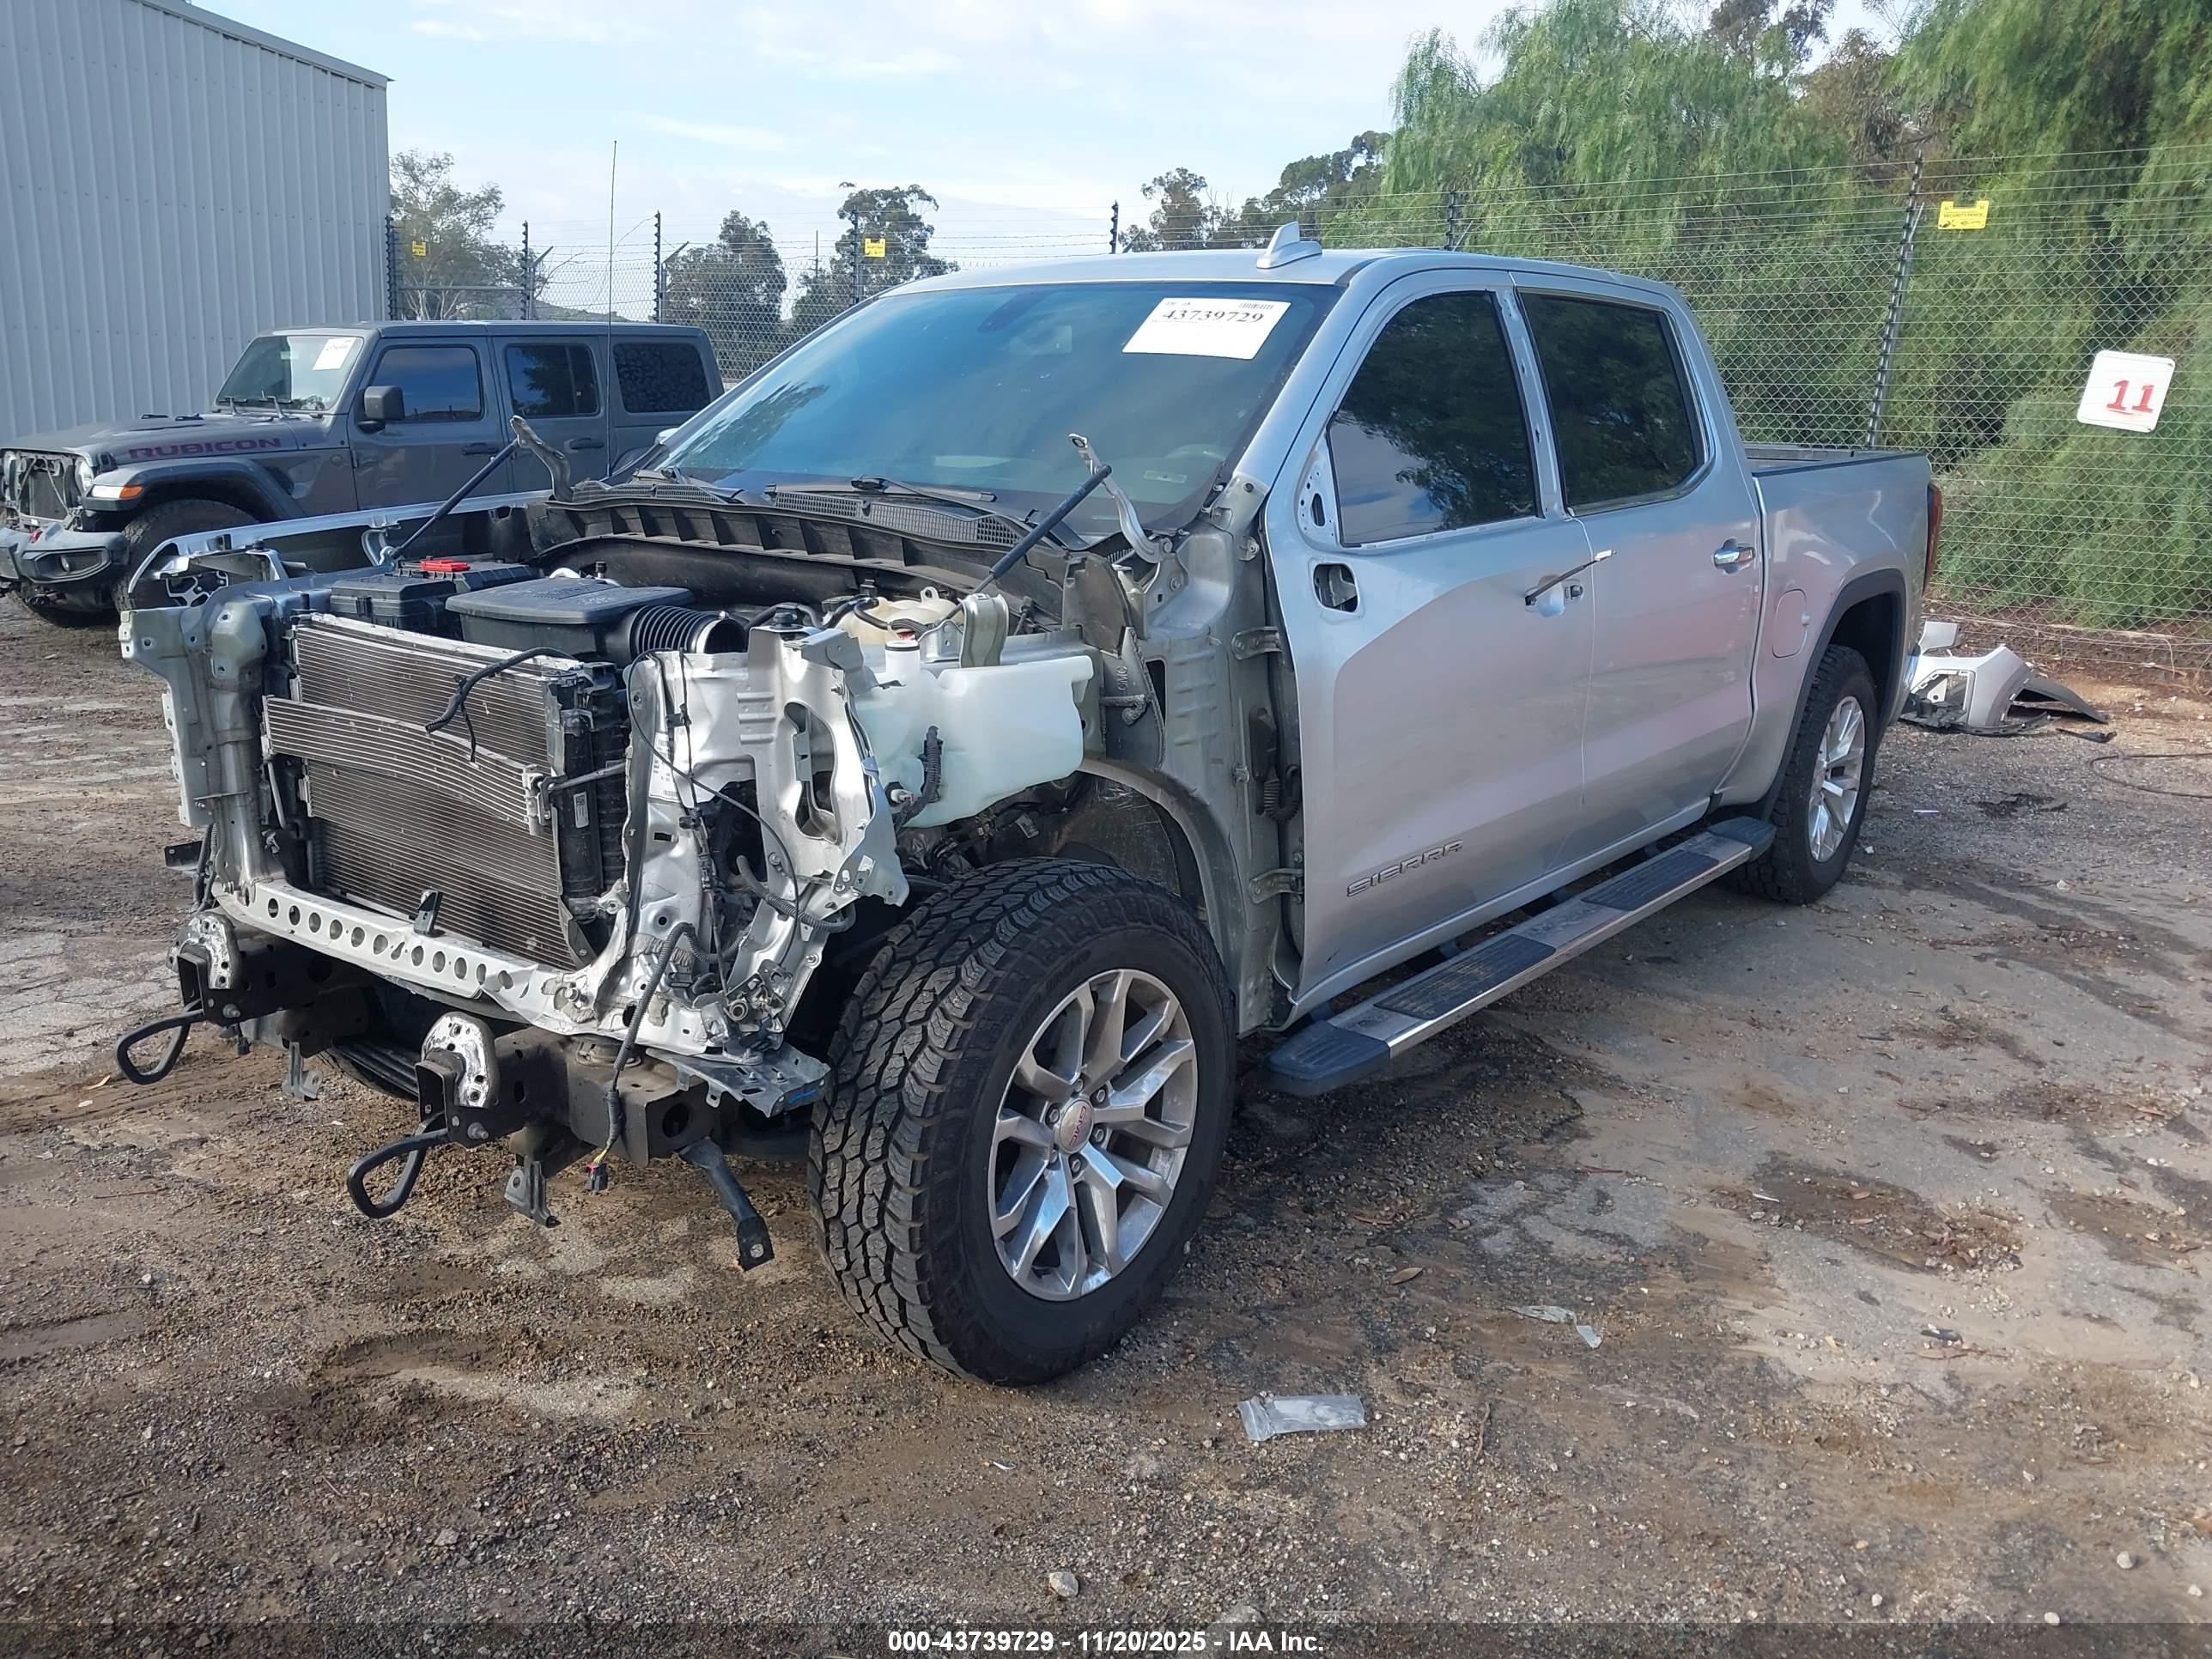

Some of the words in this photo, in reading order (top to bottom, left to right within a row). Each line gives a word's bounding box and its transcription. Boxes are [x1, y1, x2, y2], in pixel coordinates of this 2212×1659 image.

[1163, 309, 1265, 323] 43739729
[2106, 380, 2154, 413] 11
[128, 438, 282, 459] RUBICON
[1346, 839, 1463, 896] SIERRA
[1069, 1106, 1087, 1146] GMC
